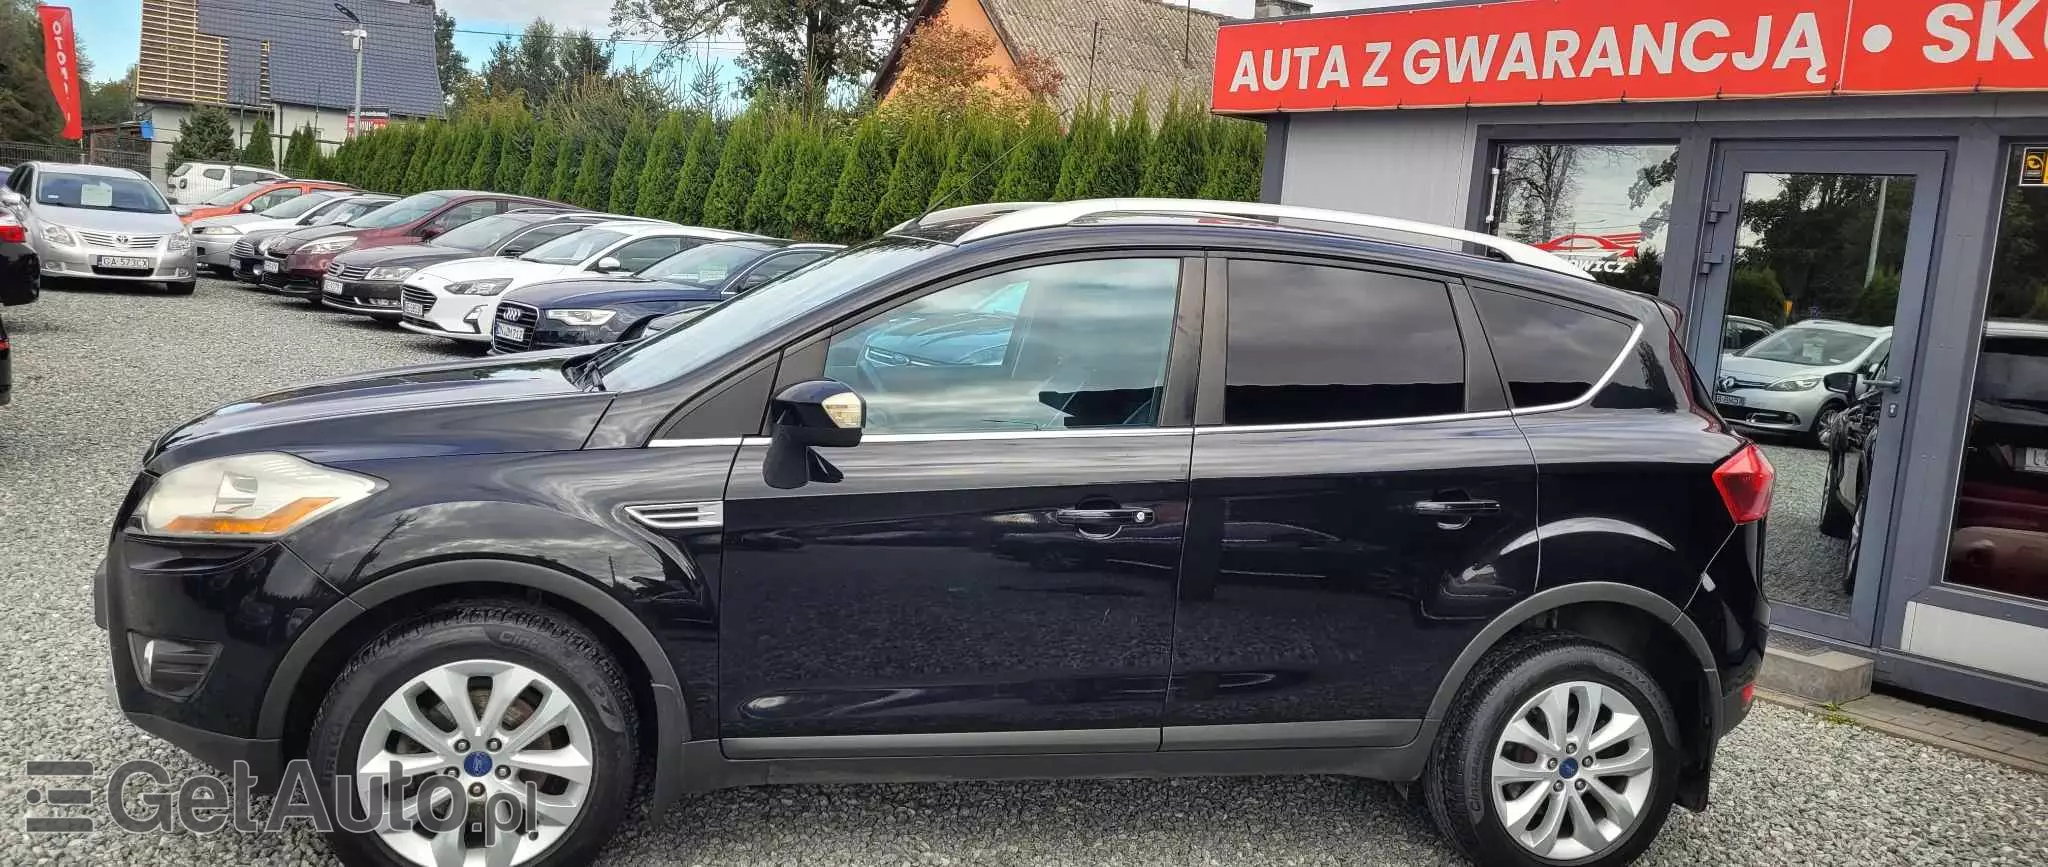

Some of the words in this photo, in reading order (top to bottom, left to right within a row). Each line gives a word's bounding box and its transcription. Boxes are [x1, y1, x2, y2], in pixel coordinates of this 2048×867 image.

[1229, 44, 1350, 93] AUTA
[1362, 41, 1392, 87] Z
[1402, 12, 1827, 84] GWARANCJĄ
[1922, 0, 2048, 64] SK
